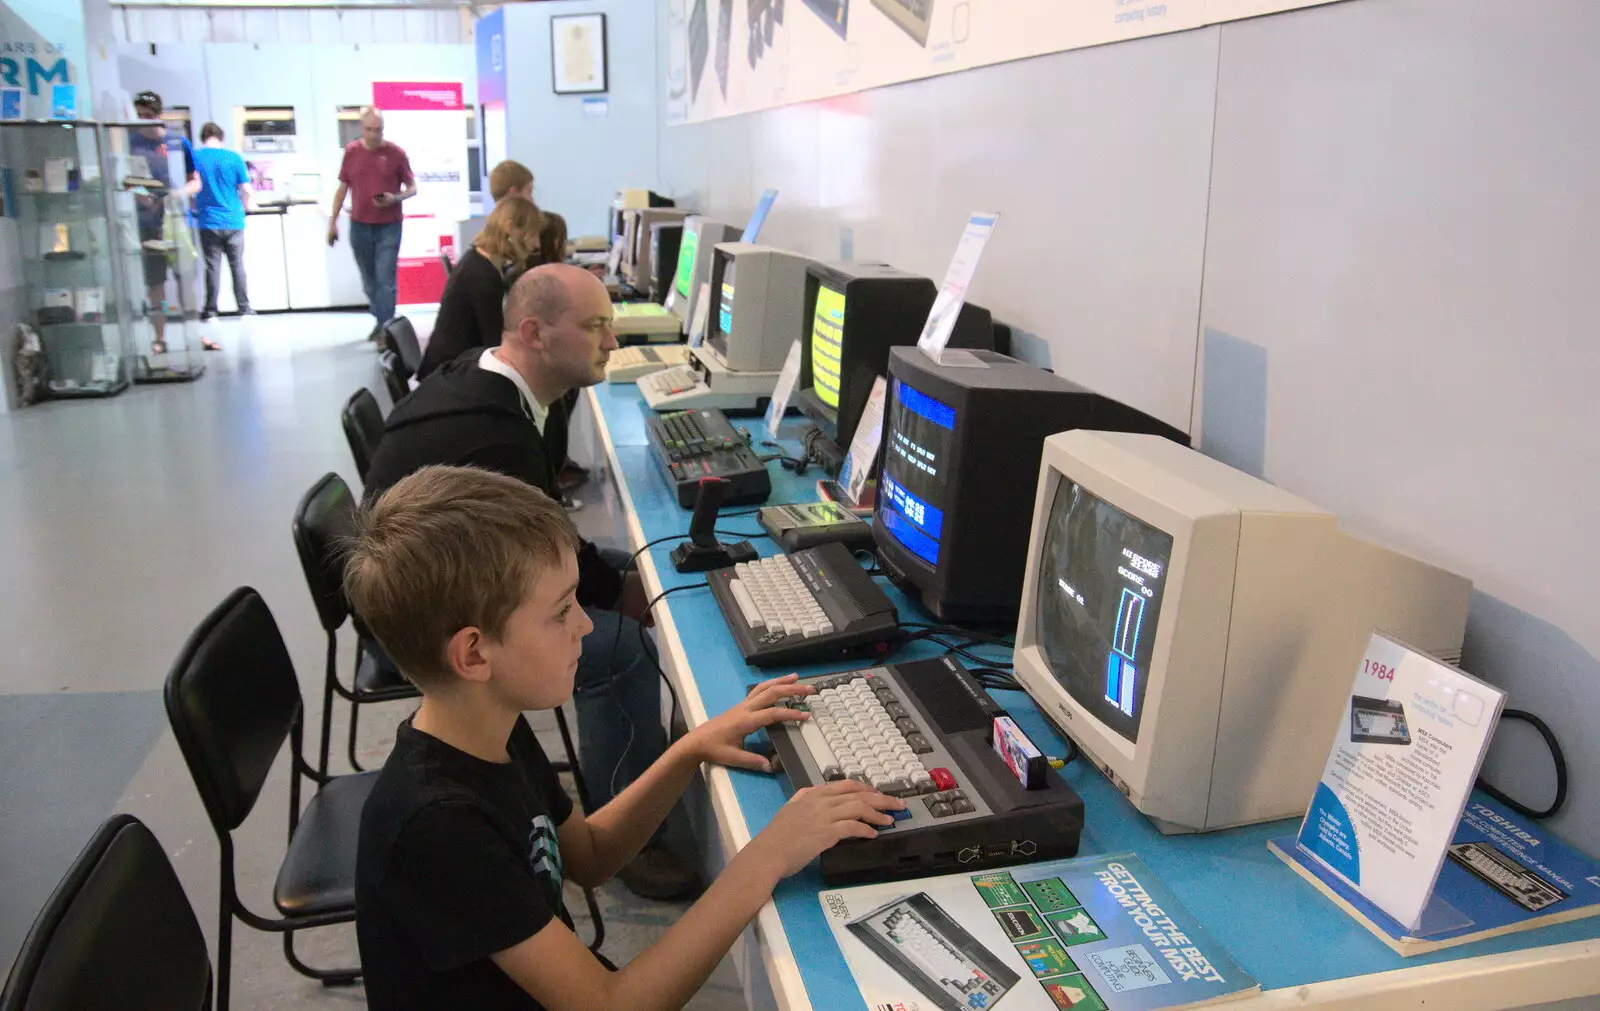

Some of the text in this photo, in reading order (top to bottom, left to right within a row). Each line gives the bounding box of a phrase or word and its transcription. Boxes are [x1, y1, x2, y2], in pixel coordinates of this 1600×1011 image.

[1122, 548, 1161, 573] HI SCORE
[1118, 566, 1144, 586] SCORE
[1141, 586, 1153, 597] 00
[1365, 659, 1394, 682] 1984
[1418, 728, 1452, 750] MSX Computers
[1473, 805, 1540, 846] TOSHIBA
[1477, 821, 1525, 850] COMPUTER
[1488, 833, 1537, 864] REFERENCE
[1536, 865, 1573, 889] MANUAL
[824, 894, 842, 919] EDITION
[834, 893, 851, 921] GENERAL
[1007, 912, 1026, 936] EDUCATION
[1094, 870, 1201, 982] FROM YOUR MSX
[1107, 862, 1226, 984] GETTING THE BEST
[1090, 953, 1126, 993] COMPUTING
[1105, 960, 1127, 981] HOME
[1119, 964, 1130, 974] TO
[1122, 957, 1143, 977] GUIDE
